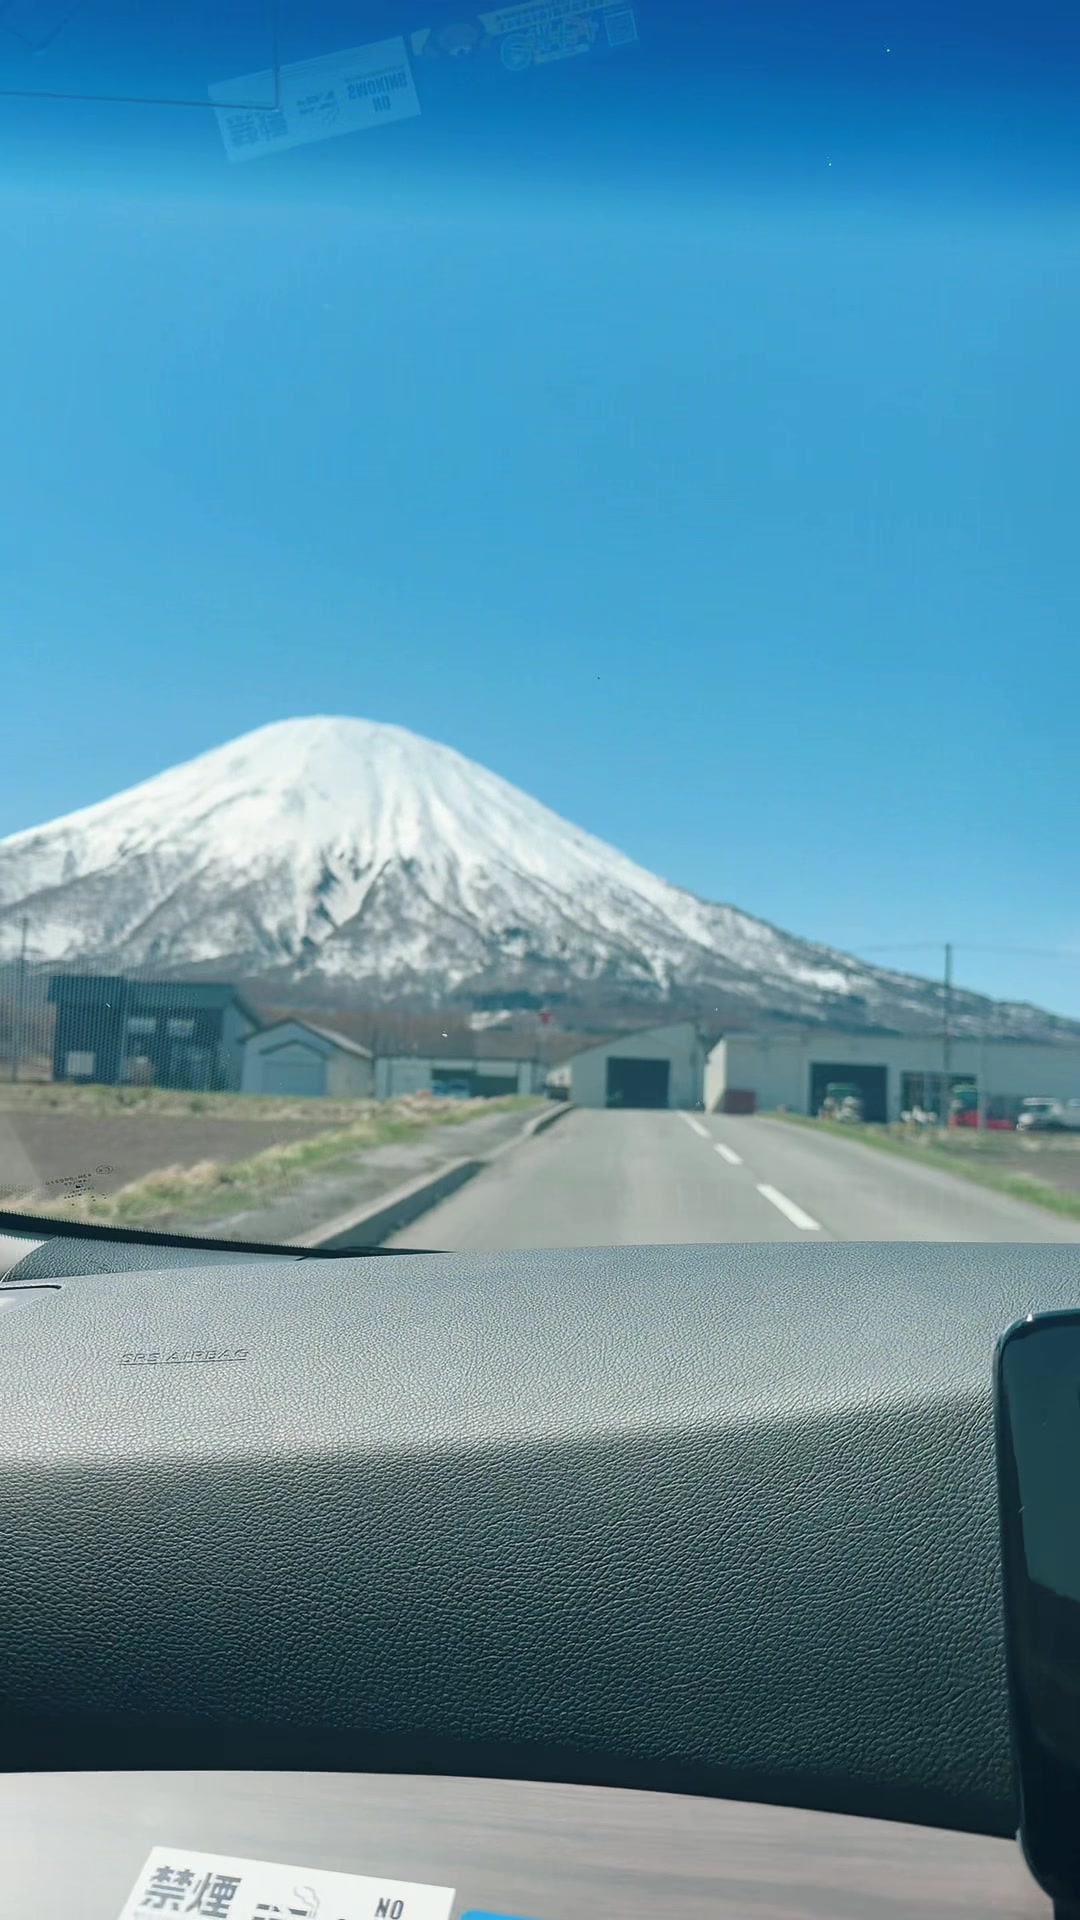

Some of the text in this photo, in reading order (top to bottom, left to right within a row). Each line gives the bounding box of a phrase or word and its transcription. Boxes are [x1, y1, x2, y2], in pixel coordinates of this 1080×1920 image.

[165, 1348, 249, 1361] AIRBAG
[139, 1866, 242, 1918] 禁煙
[374, 1897, 405, 1919] NO
